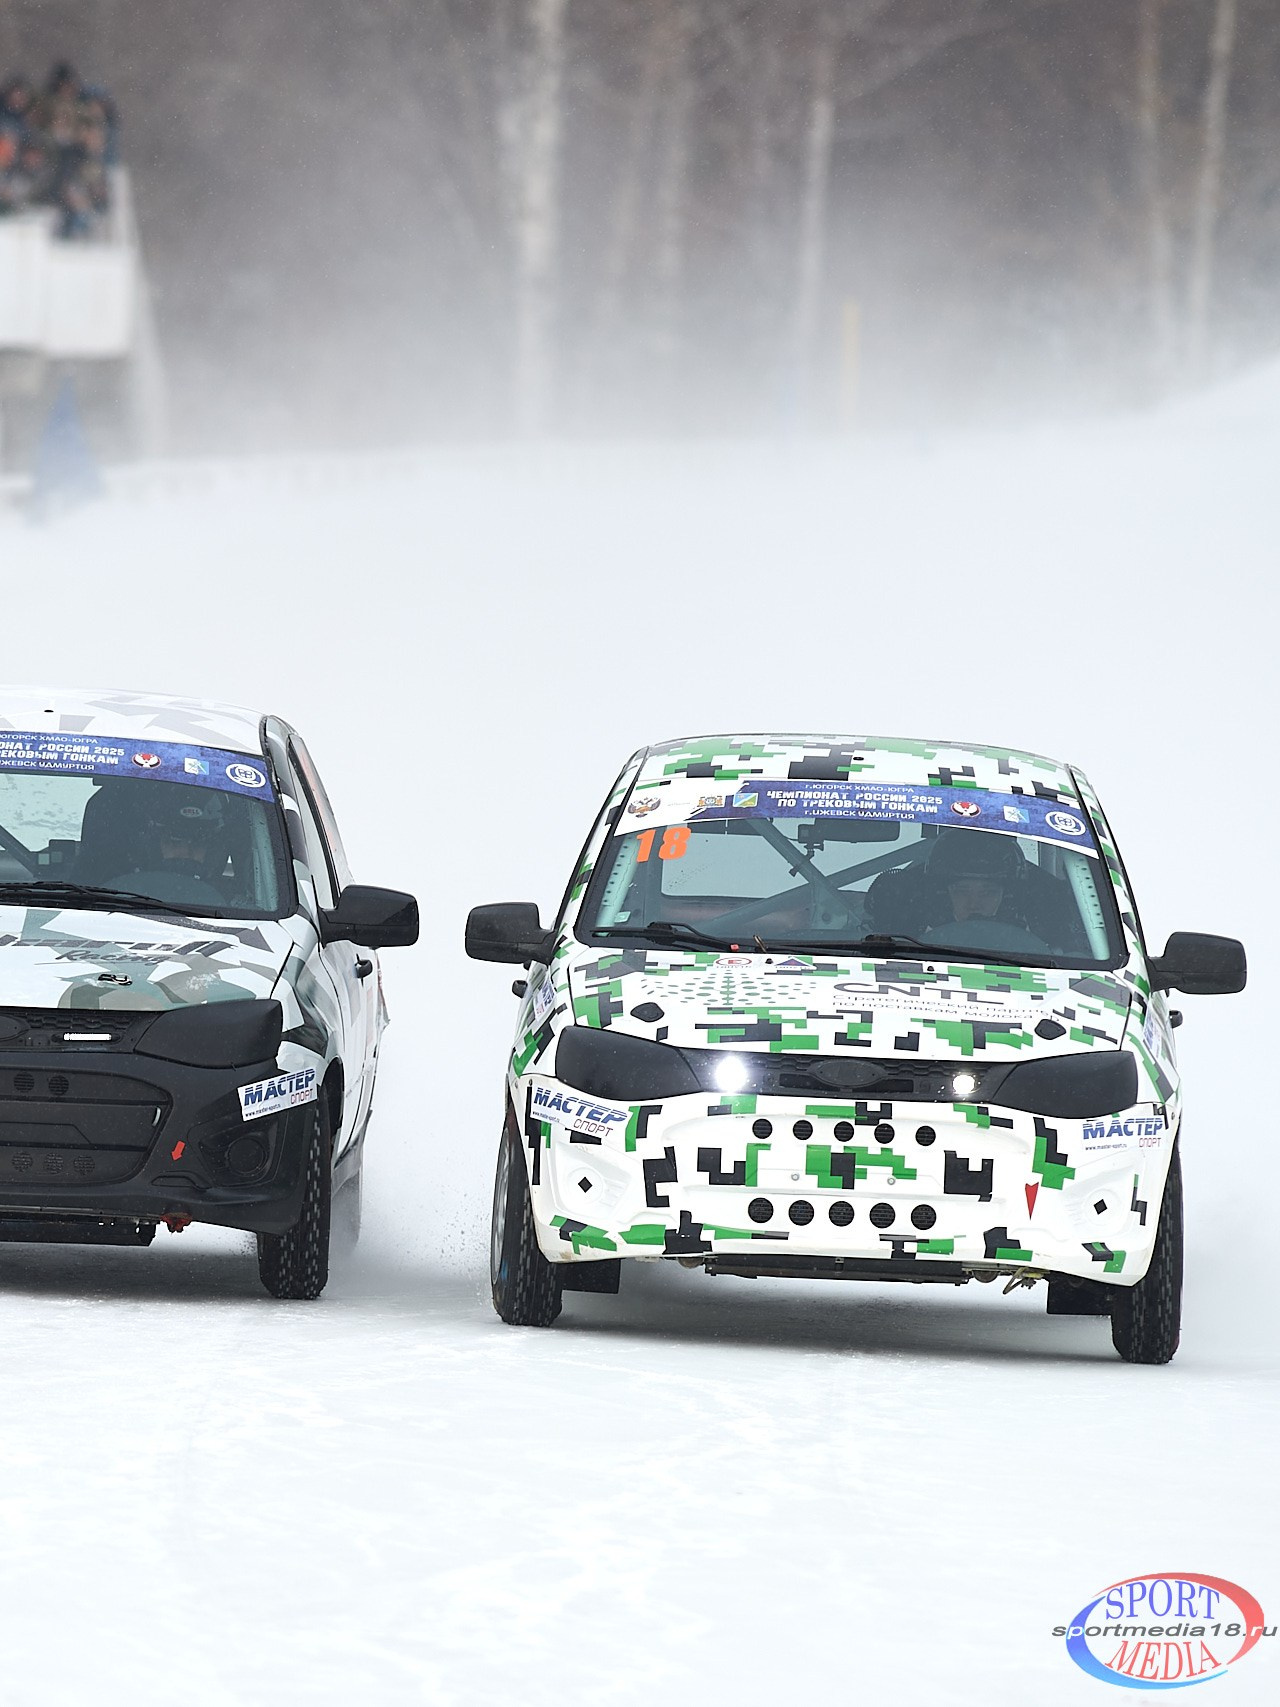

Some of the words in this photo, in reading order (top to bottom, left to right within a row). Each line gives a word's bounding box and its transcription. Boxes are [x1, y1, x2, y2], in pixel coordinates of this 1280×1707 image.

[38, 743, 89, 754] РОССИИ
[94, 746, 125, 756] 2025
[62, 753, 119, 764] ГОНКАМ
[767, 790, 849, 800] ЧЕМПИОНАТ
[855, 792, 908, 803] РОССИИ
[911, 795, 943, 805] 2025
[777, 798, 796, 807] ПО
[801, 799, 877, 810] ТРЕКОВЫМ
[881, 802, 938, 813] ГОНКАМ
[636, 827, 692, 863] 18
[244, 1068, 315, 1106] МАСТЕР
[533, 1087, 628, 1124] МАСТЕР
[573, 1118, 614, 1137] СПОРТ
[1083, 1117, 1163, 1140] МАСТЕР
